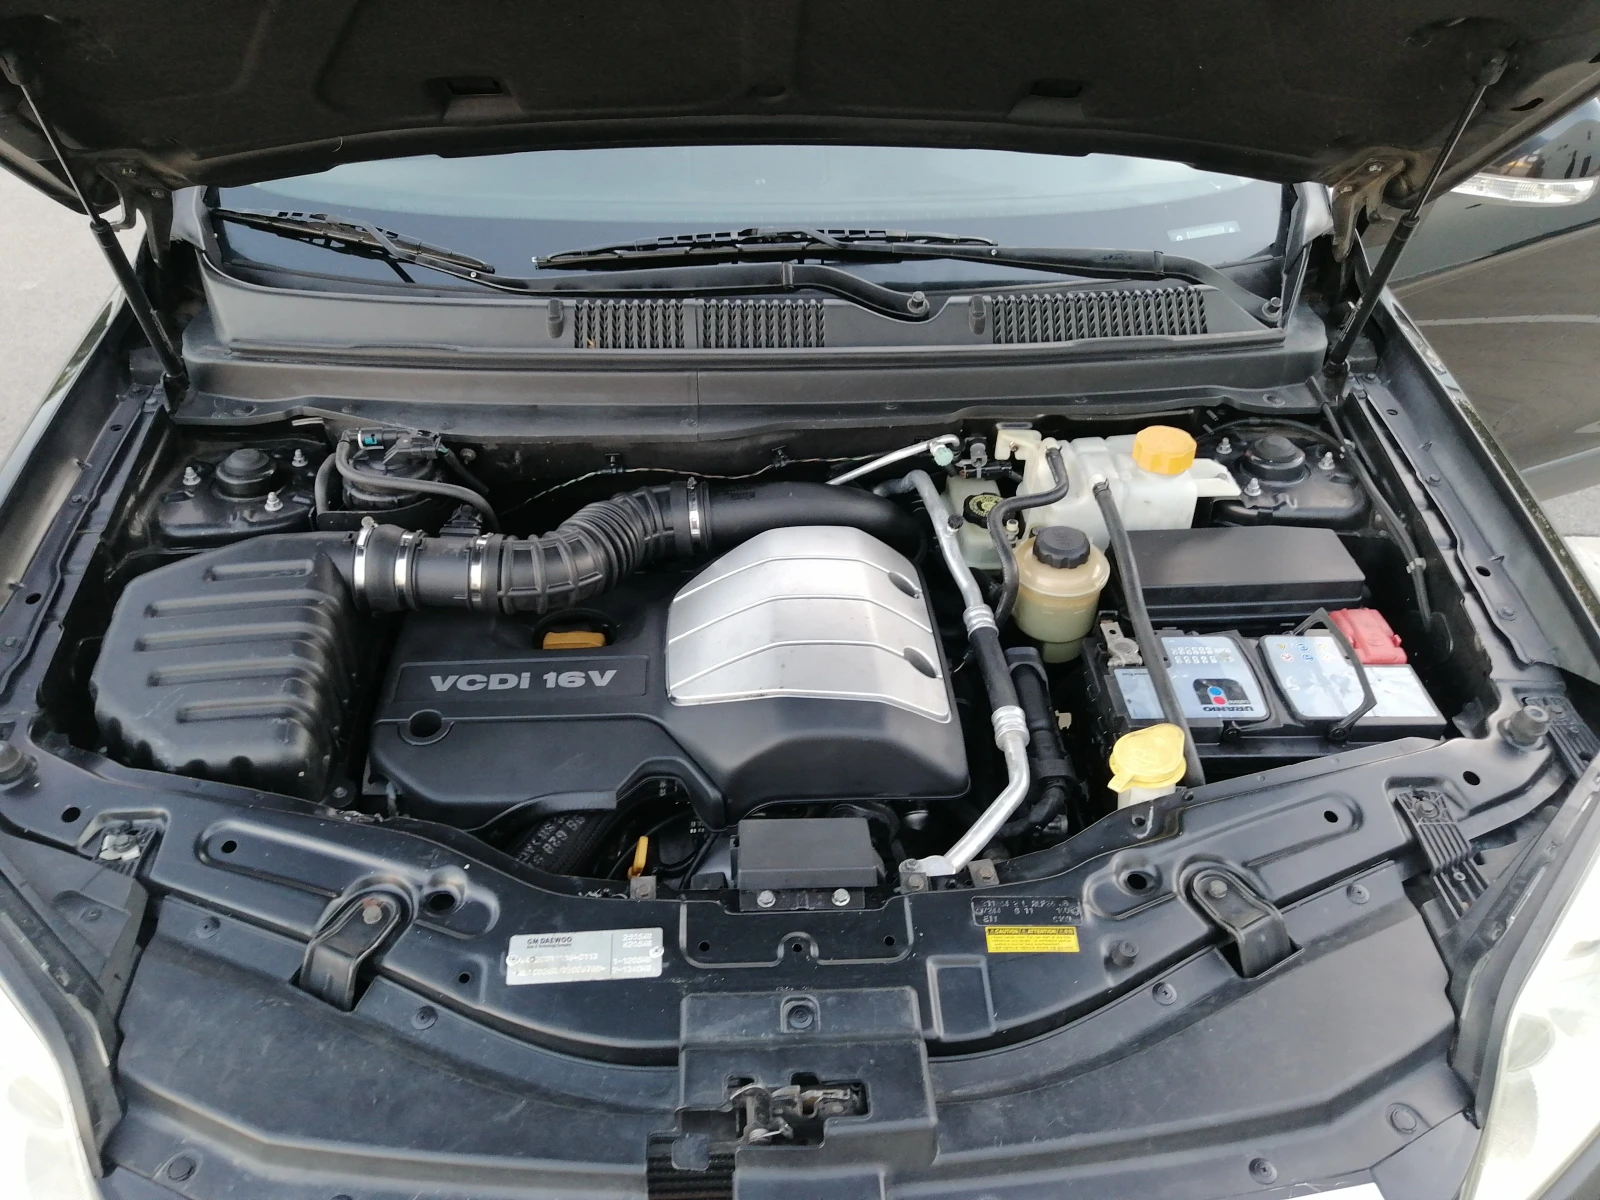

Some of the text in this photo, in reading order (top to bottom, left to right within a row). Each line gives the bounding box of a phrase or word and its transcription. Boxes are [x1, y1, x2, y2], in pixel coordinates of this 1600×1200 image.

[543, 669, 617, 689] 16V
[526, 936, 572, 945] GM DAEWOO
